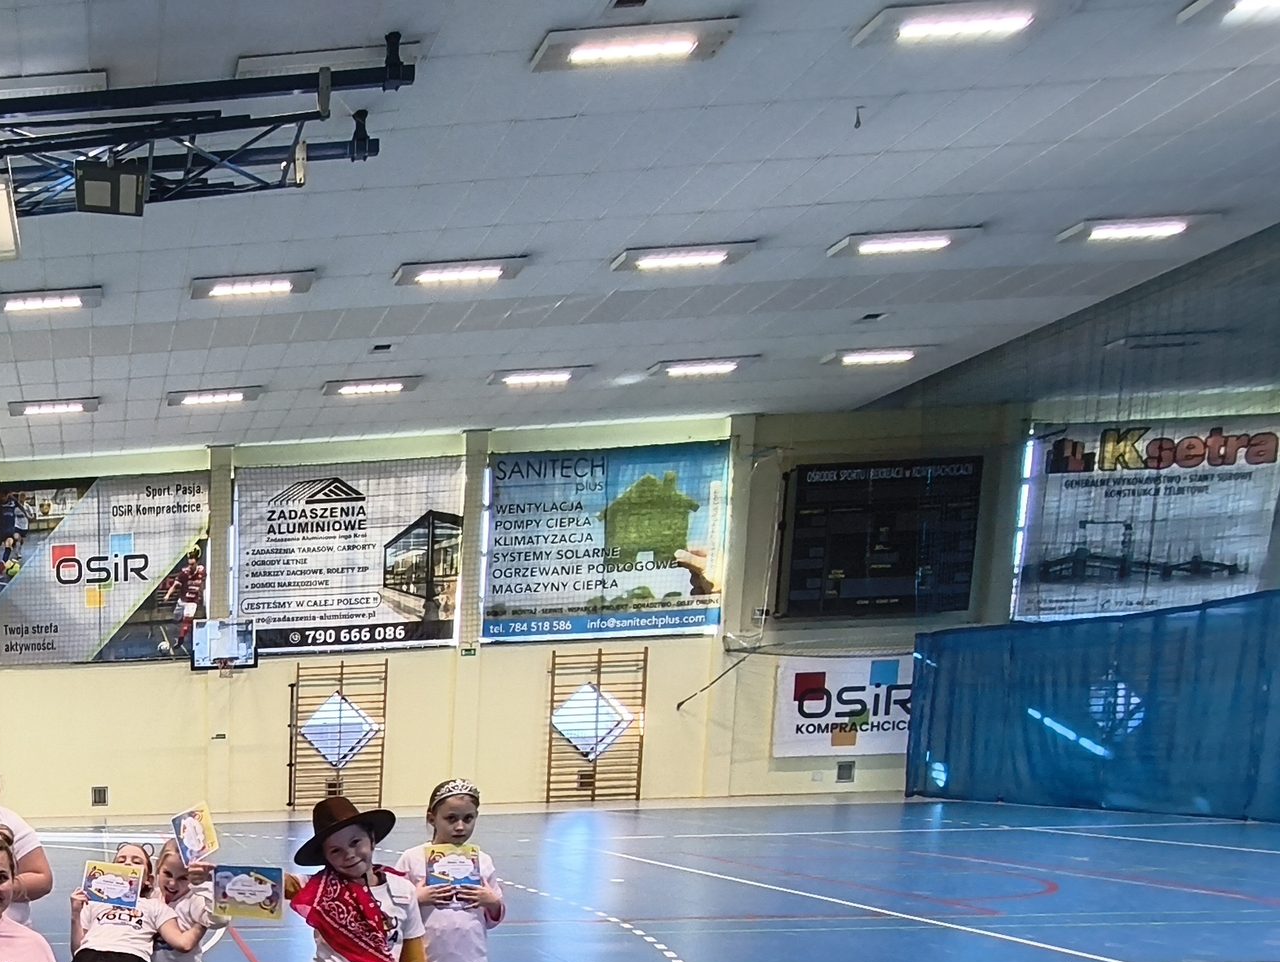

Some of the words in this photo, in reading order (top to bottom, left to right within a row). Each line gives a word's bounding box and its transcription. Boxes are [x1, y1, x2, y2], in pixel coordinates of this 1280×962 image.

[1097, 427, 1279, 471] Ksetra
[496, 456, 605, 481] SANITECH
[145, 485, 173, 497] Sport.
[175, 483, 204, 496] Pasja.
[575, 481, 604, 495] plus
[112, 504, 133, 518] OSiR
[136, 502, 203, 516] Komprachcice.
[267, 505, 366, 522] ZADASZENIA
[496, 501, 583, 515] WENTYLACJA
[267, 519, 367, 535] ALUMINIOWE
[494, 518, 542, 531] POMPY
[546, 516, 591, 529] CIEPŁA
[494, 533, 593, 547] KLIMATYZACJA
[251, 548, 296, 556] ZADASZENIA
[336, 543, 377, 552] CARPORTY
[493, 550, 553, 563] SYSTEMY
[556, 547, 620, 559] SOLARNE
[56, 553, 149, 584] OSiR
[492, 564, 583, 579] OGRZEWANIE
[588, 560, 678, 574] PODŁOGOWE
[492, 581, 568, 595] MAGAZYNY
[573, 579, 618, 592] CIEPŁA
[244, 599, 293, 611] JESTEŚMY
[295, 600, 304, 608] W
[336, 596, 372, 607] POLSCE
[4, 623, 29, 636] Twoja
[32, 622, 58, 635] strefa
[489, 624, 505, 633] tel.
[509, 622, 528, 632] 784
[531, 621, 550, 632] 518
[552, 620, 572, 631] 586
[587, 613, 705, 630] info@sanitechplus.com
[305, 630, 335, 644] 790
[340, 628, 370, 642] 666
[374, 626, 405, 640] 086
[4, 638, 56, 654] aktywności.
[797, 682, 912, 718] OSiR
[795, 720, 910, 735] KOMPRACHCIC
